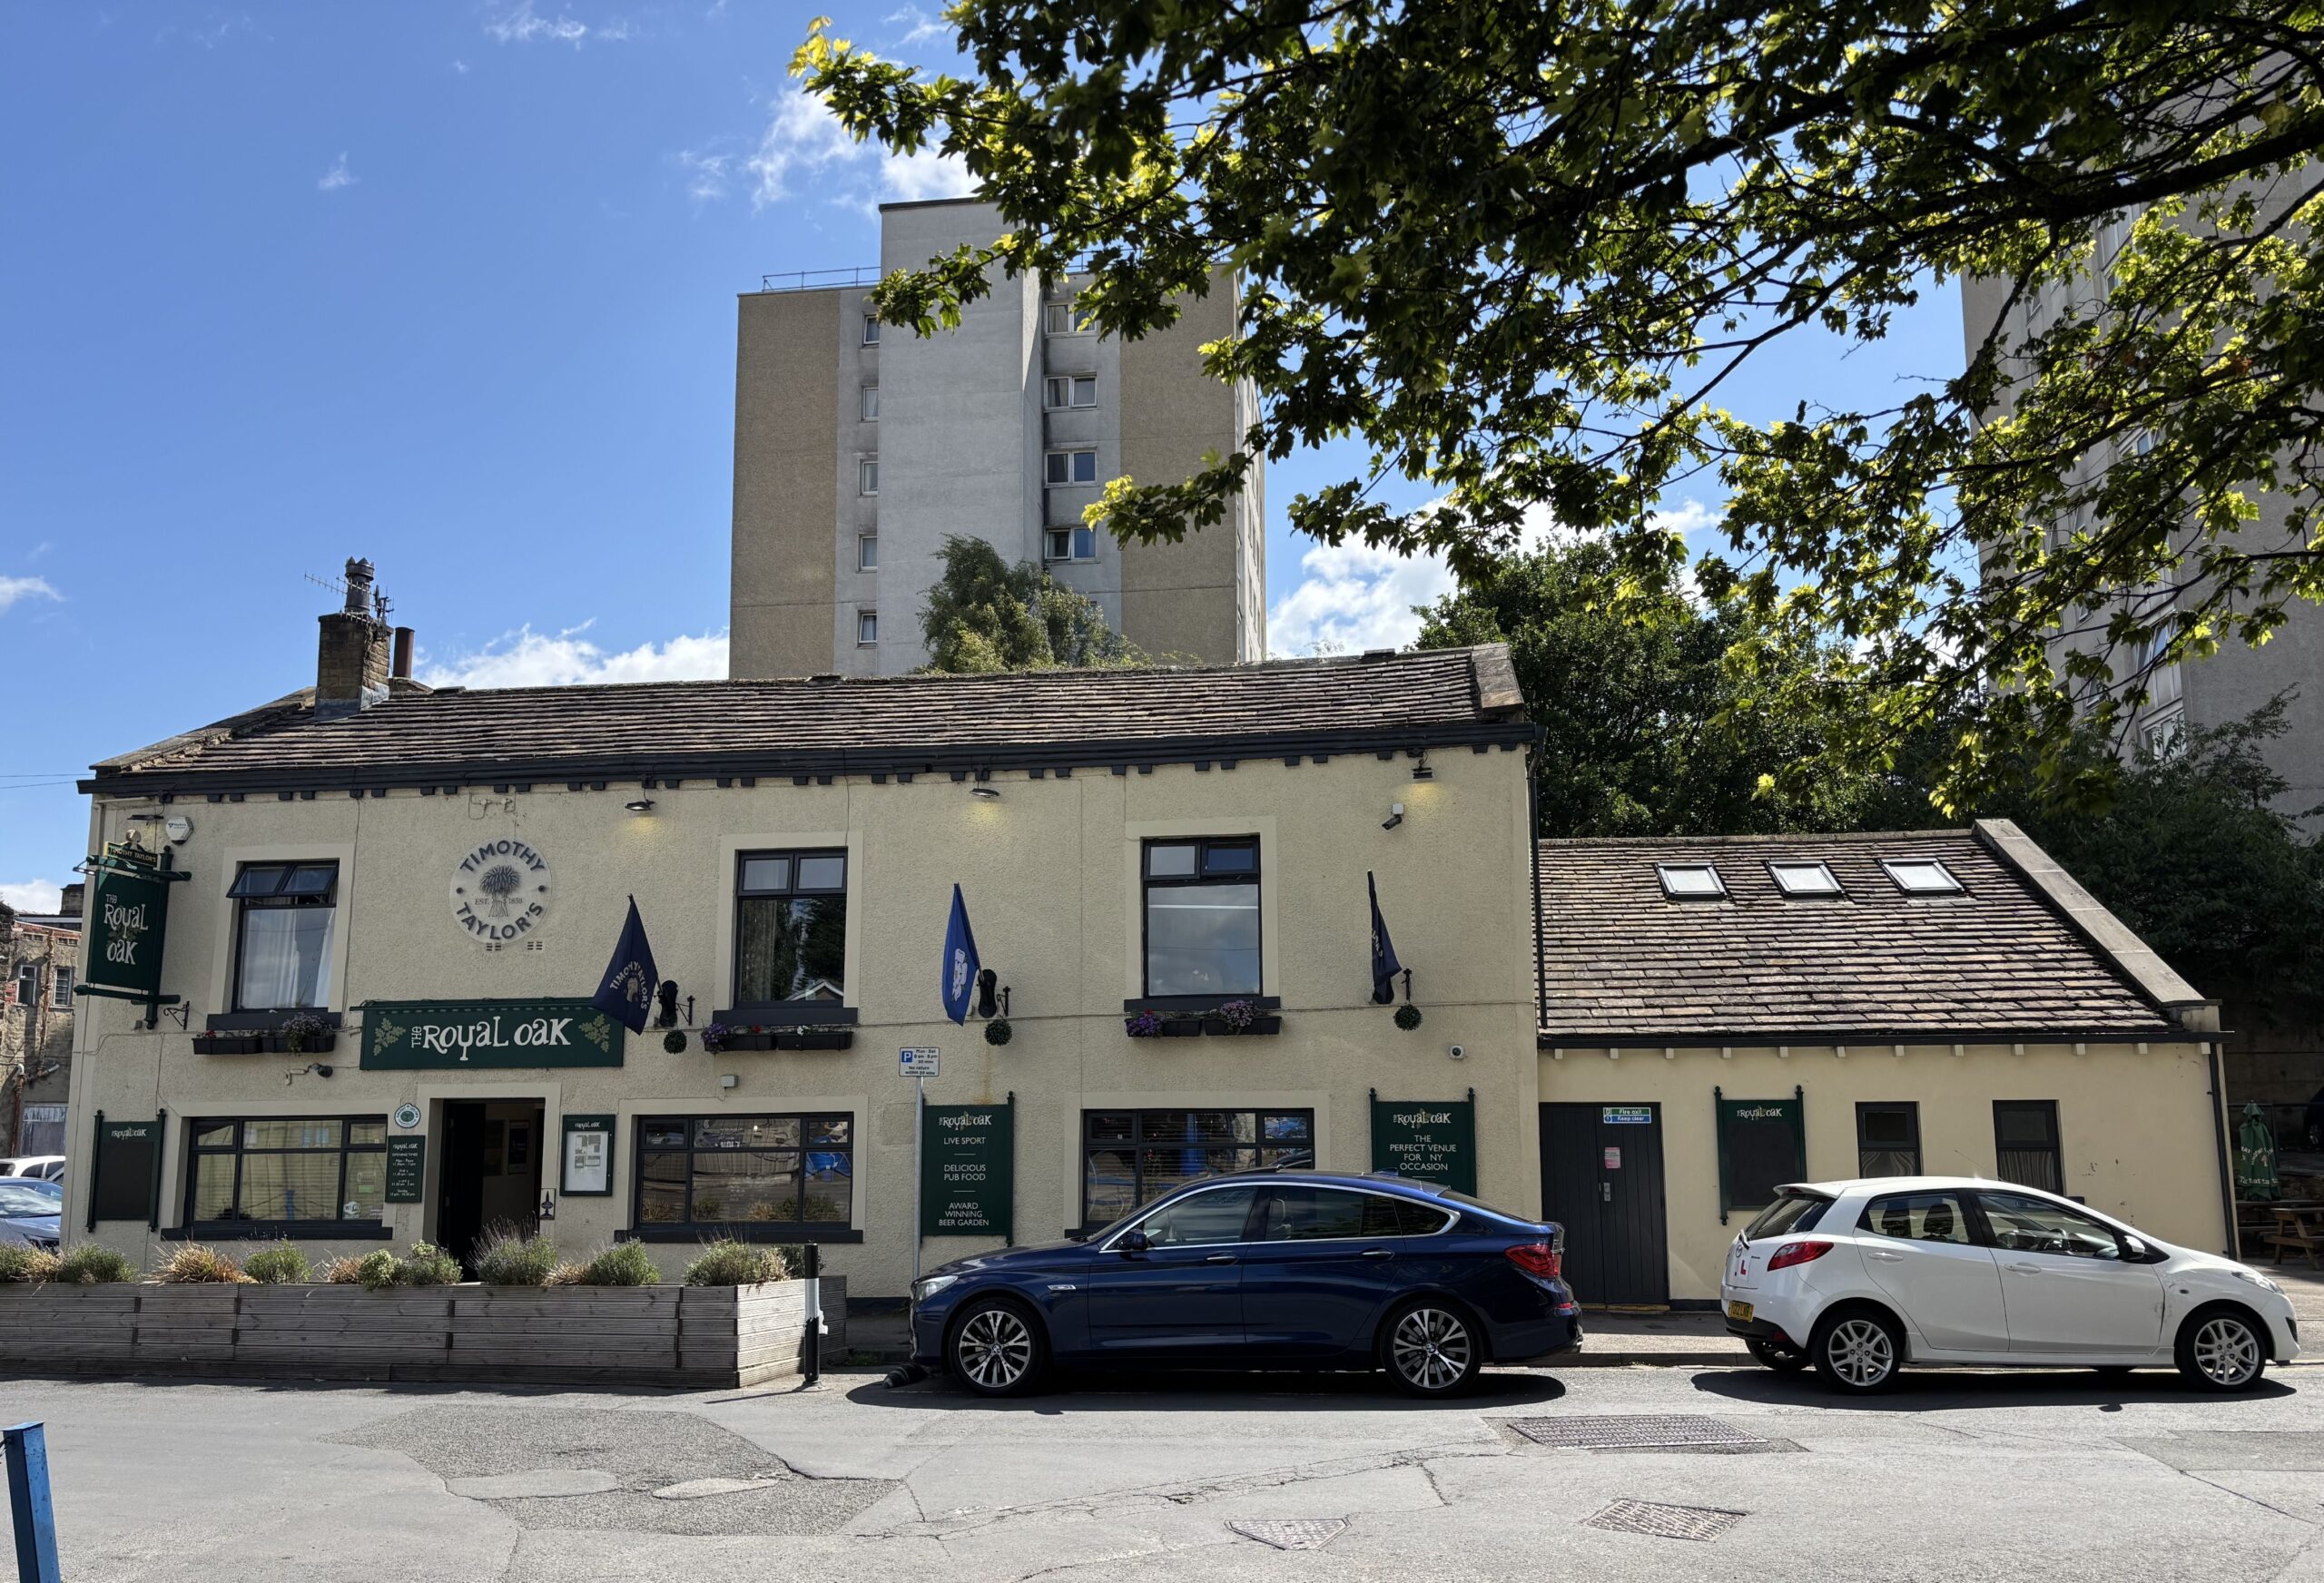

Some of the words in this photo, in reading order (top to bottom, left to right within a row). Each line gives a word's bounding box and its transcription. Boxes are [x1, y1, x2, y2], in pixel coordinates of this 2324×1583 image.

[459, 840, 545, 871] TIMOTHY
[457, 901, 543, 940] TAYLOR'S
[904, 1052, 911, 1062] P
[1413, 1135, 1432, 1143] THE
[1400, 1163, 1448, 1171] OCCASION
[1740, 1259, 1747, 1275] L
